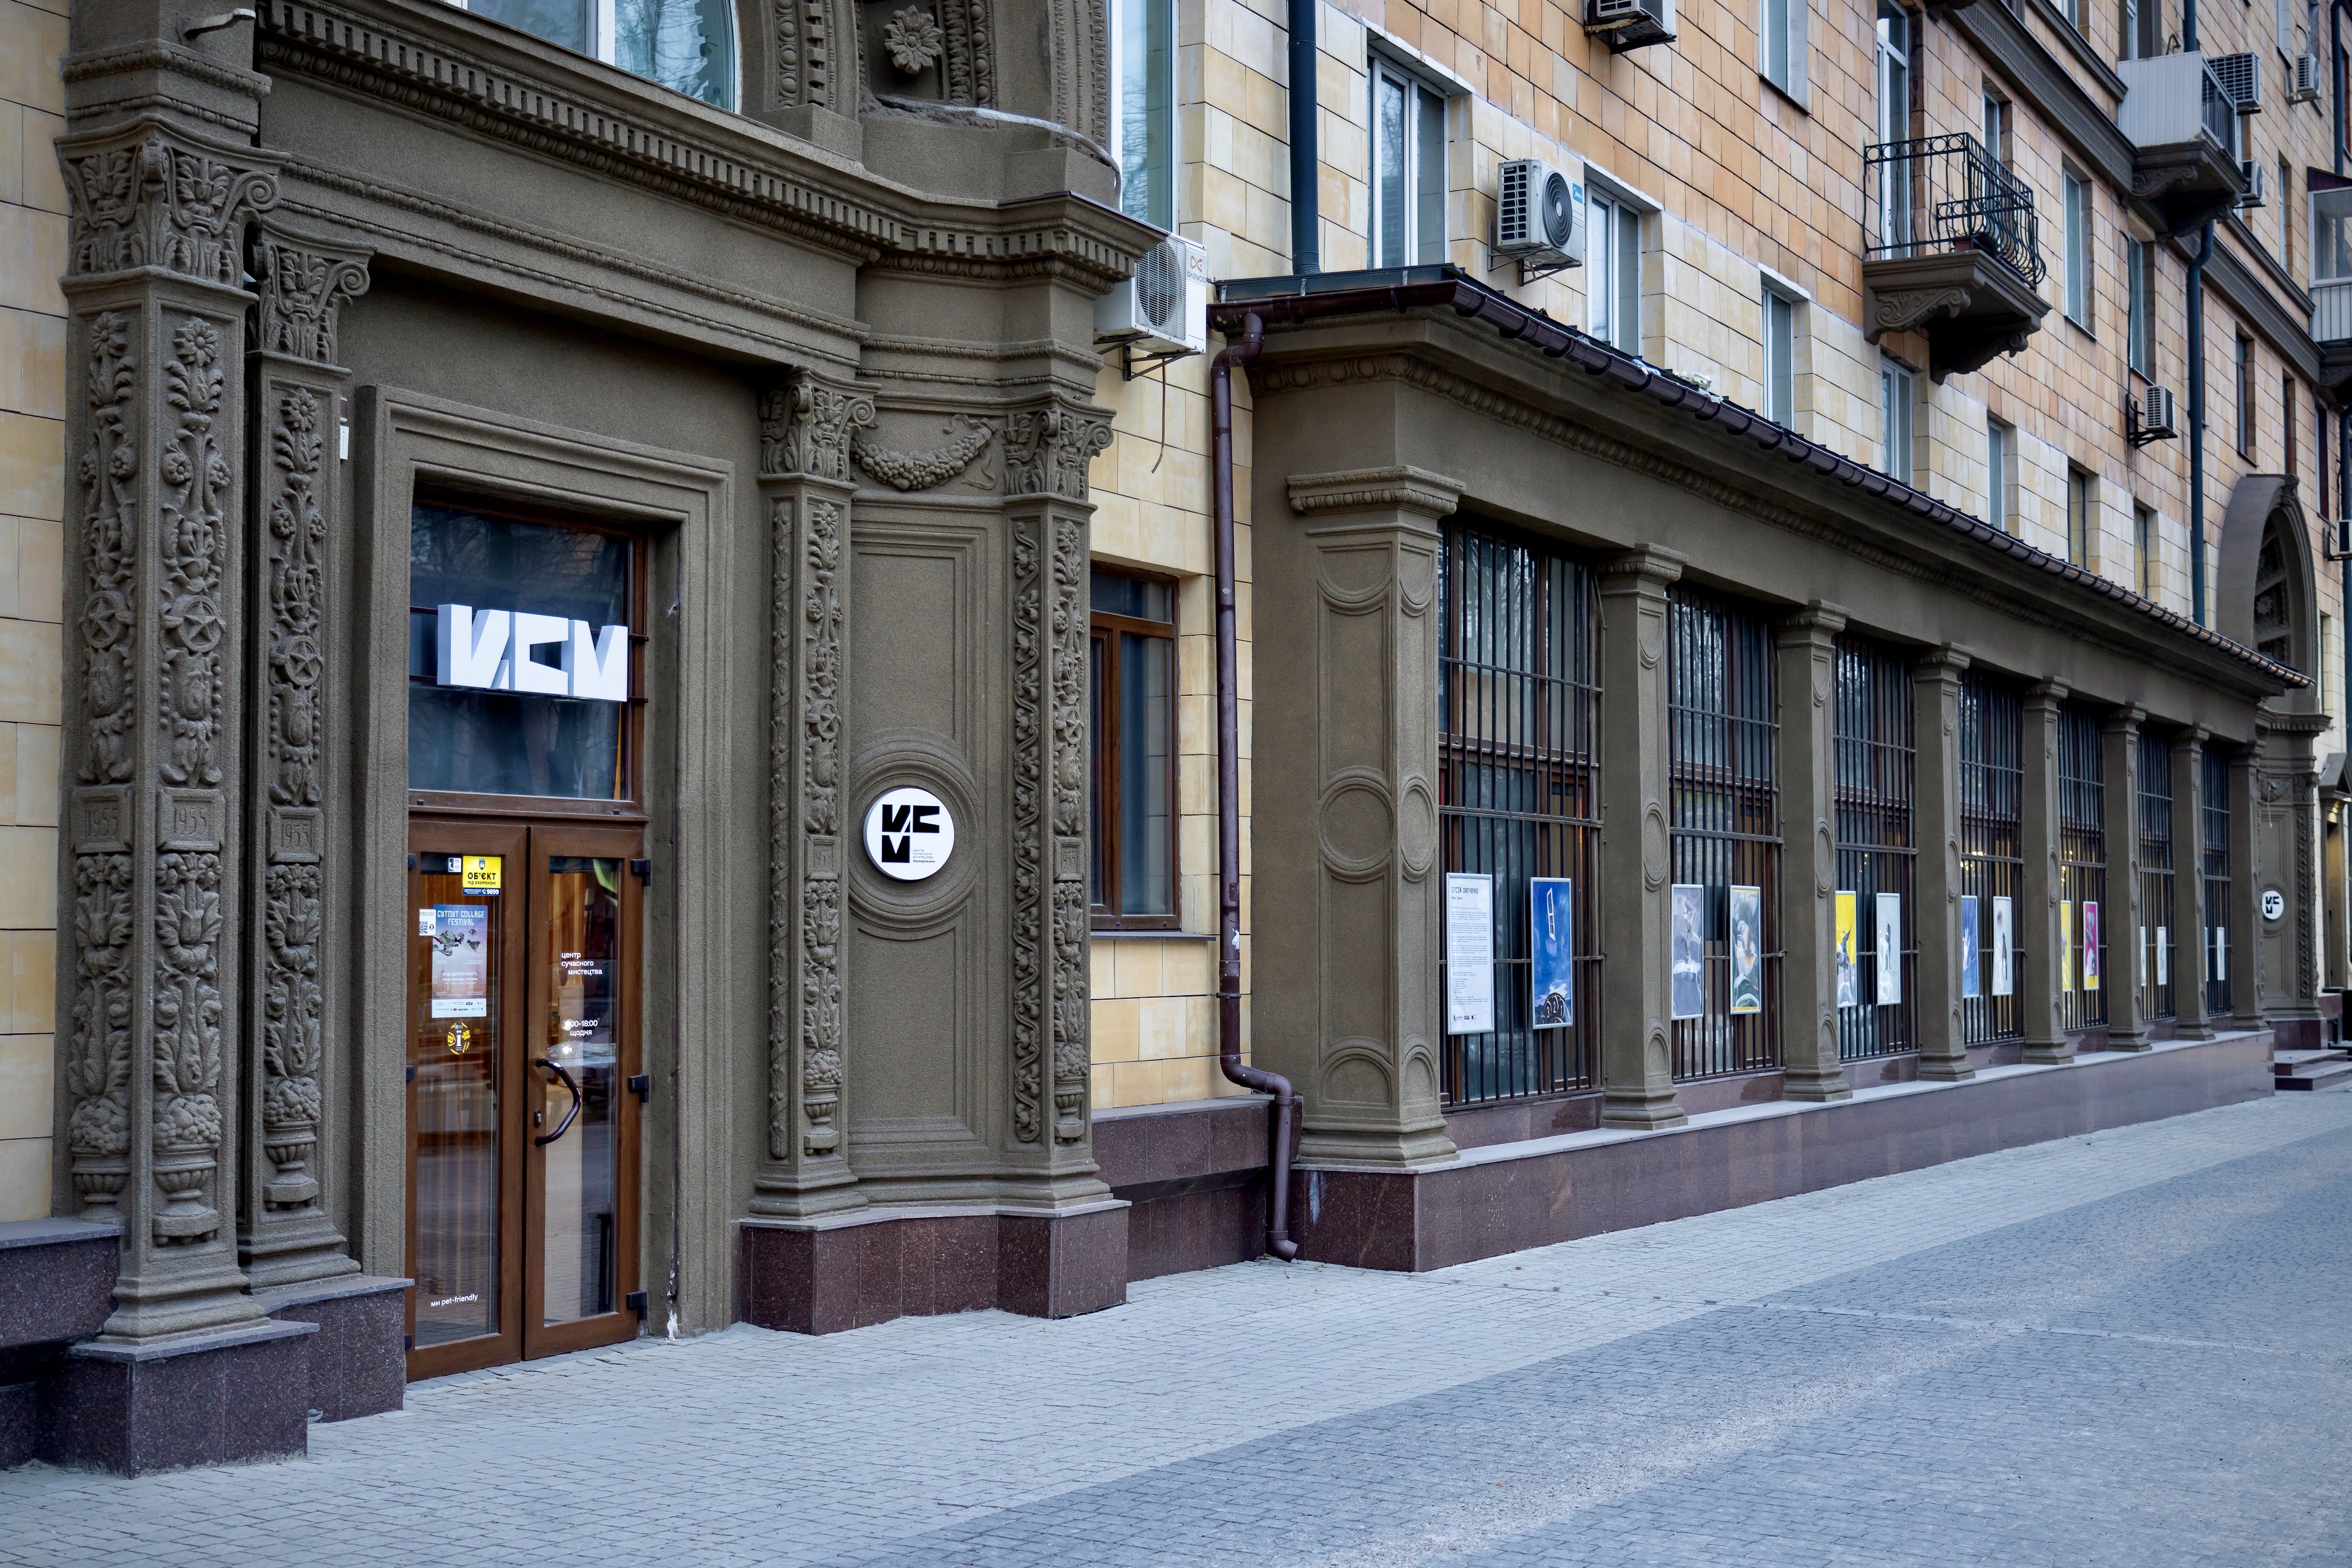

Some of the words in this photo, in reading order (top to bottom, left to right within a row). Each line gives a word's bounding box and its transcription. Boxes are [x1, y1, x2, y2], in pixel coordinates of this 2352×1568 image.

[1187, 271, 1206, 284] DAEWOO
[86, 808, 119, 837] 1955
[174, 807, 208, 836] 1955
[280, 823, 310, 849] 1955
[441, 1294, 478, 1306] pet-friendly
